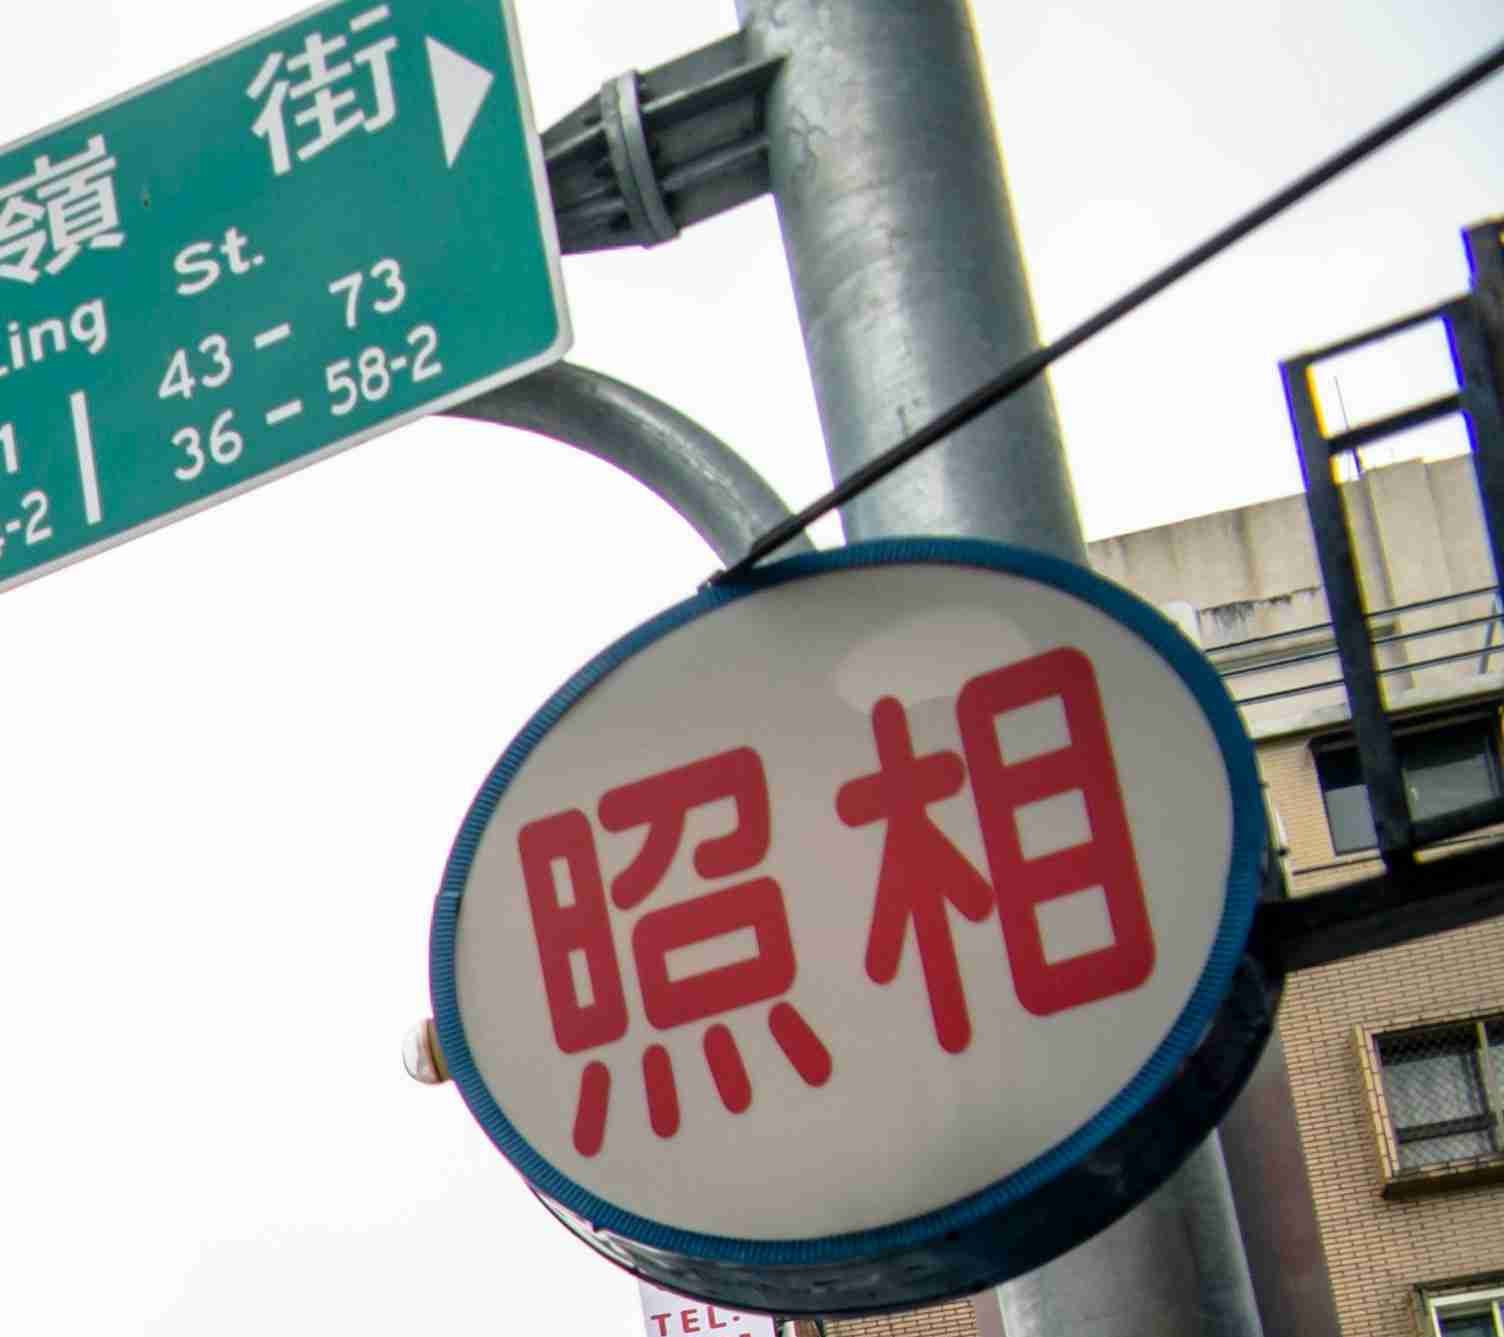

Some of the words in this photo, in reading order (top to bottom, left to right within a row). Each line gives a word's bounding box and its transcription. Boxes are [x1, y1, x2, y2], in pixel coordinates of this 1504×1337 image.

[158, 336, 234, 400] 43
[328, 259, 407, 328] 73
[174, 226, 264, 297] St.
[172, 410, 244, 481] 36
[326, 324, 442, 417] 58-2
[516, 645, 1158, 1159] 照相
[651, 1306, 740, 1337] TEL.
